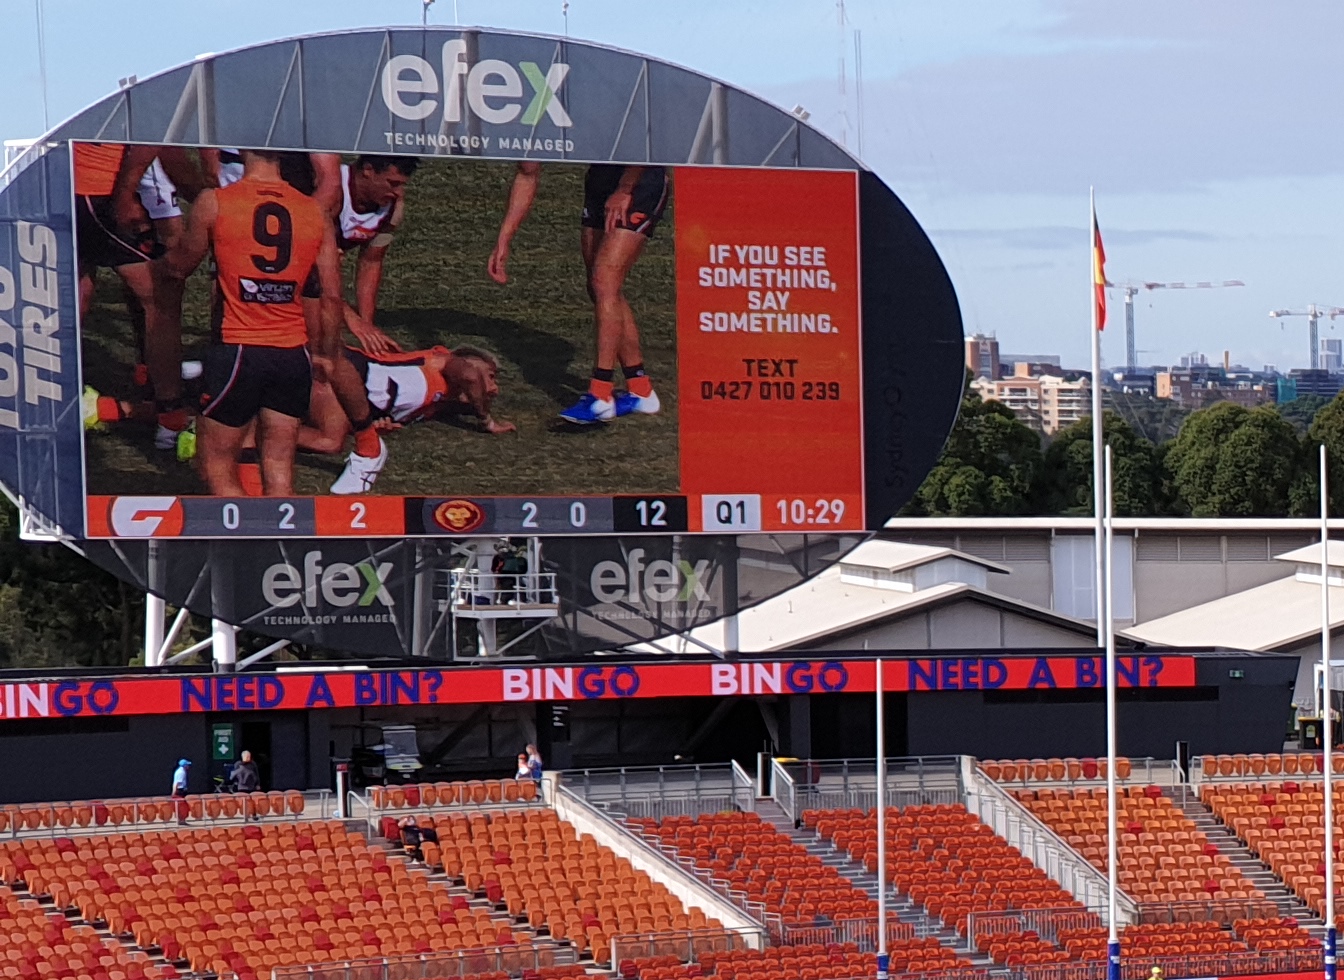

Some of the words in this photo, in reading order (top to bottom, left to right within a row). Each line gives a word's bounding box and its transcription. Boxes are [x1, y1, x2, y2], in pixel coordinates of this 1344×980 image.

[382, 39, 573, 127] efex
[384, 132, 490, 149] TECHNOLOGY
[499, 138, 574, 152] MANAGED
[251, 201, 292, 274] 9
[709, 244, 731, 264] IF
[734, 245, 778, 265] YOU
[785, 246, 826, 266] SEE
[699, 267, 837, 292] SOMETHING,
[17, 220, 62, 404] TIRES
[748, 291, 789, 310] SAY
[699, 312, 839, 333] SOMETHING.
[742, 359, 798, 377] TEXT
[701, 381, 752, 400] 0427
[759, 381, 795, 400] 010
[802, 381, 840, 400] 239
[222, 503, 240, 530] 0
[278, 503, 295, 530] 2
[350, 502, 366, 529] 2
[521, 502, 538, 528] 2
[570, 501, 586, 528] 0
[635, 500, 668, 526] 12
[716, 500, 746, 525] Q1
[776, 499, 845, 524] 10:29
[262, 551, 395, 607] efex
[590, 549, 711, 602] efex
[263, 615, 337, 625] TECHNOLOGY
[342, 614, 396, 624] MANAGED
[503, 665, 639, 700] BINGO
[711, 660, 848, 695] BINGO
[908, 658, 1008, 690] NEED
[1028, 656, 1057, 688] A
[1075, 656, 1164, 688] BN?
[0, 682, 119, 718] INGO
[181, 673, 285, 712] NEED
[305, 673, 335, 708] A
[354, 669, 443, 706] BIN?
